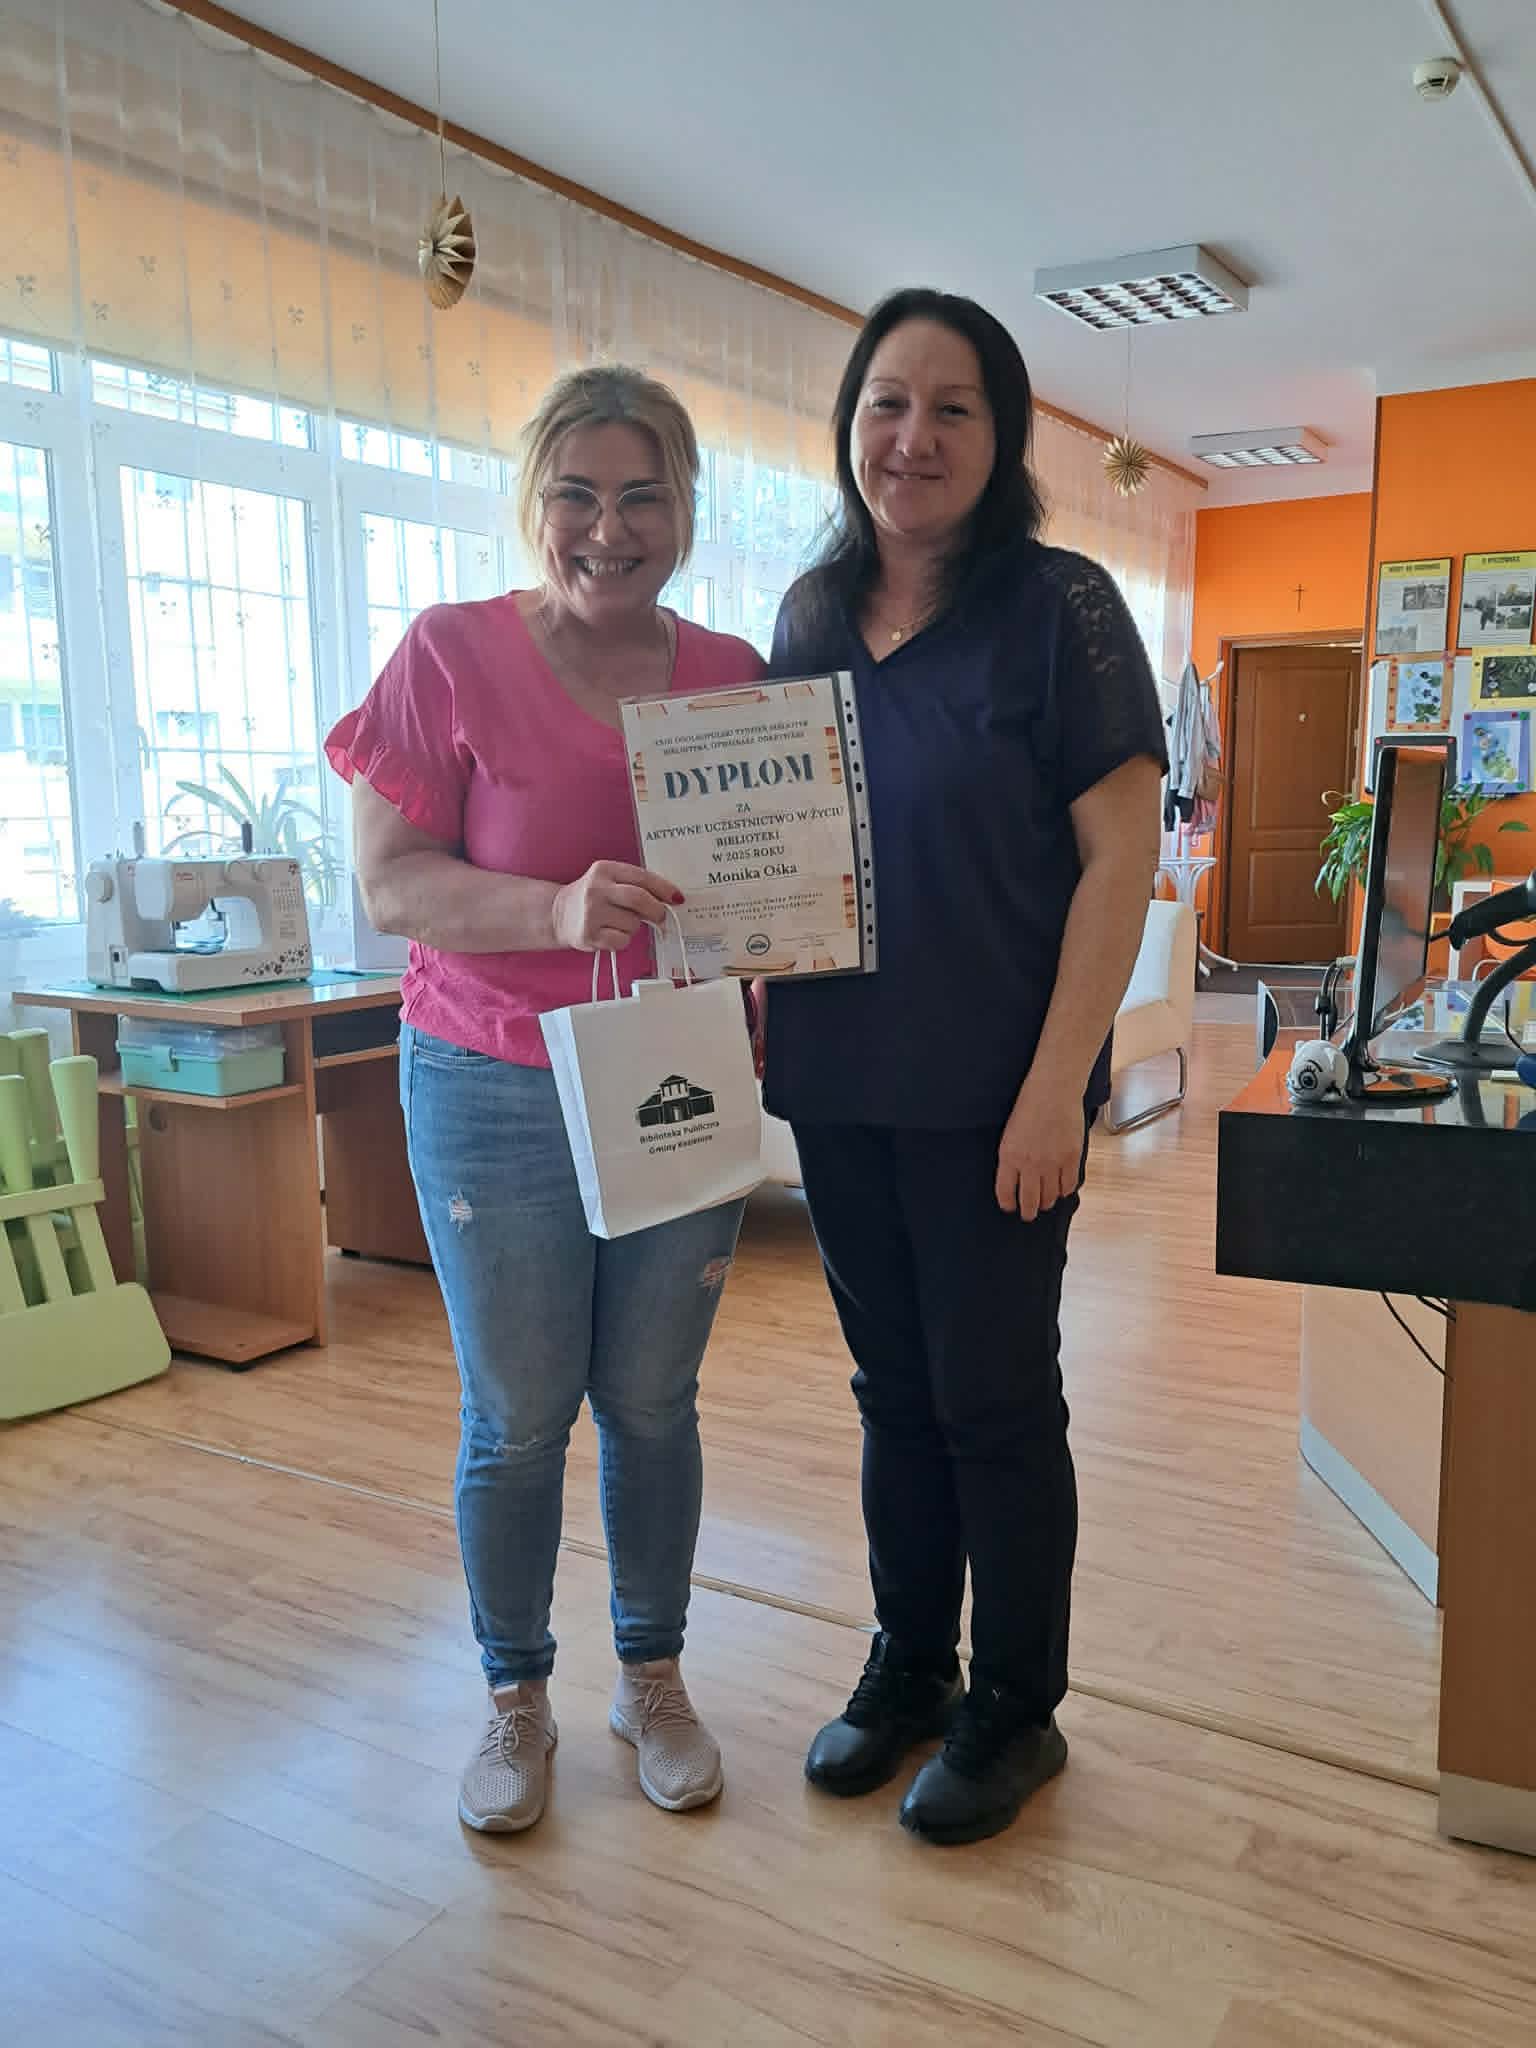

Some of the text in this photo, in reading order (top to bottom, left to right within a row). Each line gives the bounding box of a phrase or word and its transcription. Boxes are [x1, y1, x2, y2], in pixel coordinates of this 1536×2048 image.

[664, 752, 815, 799] DYPLOM
[736, 802, 751, 813] ZA
[646, 823, 704, 841] AKTYWNE
[705, 812, 795, 833] UCZESTNICTWO
[797, 809, 809, 821] W
[716, 830, 780, 847] BIBLIOTEKI
[712, 845, 786, 863] W 2025 ROKU
[708, 862, 798, 885] Monika Ośka
